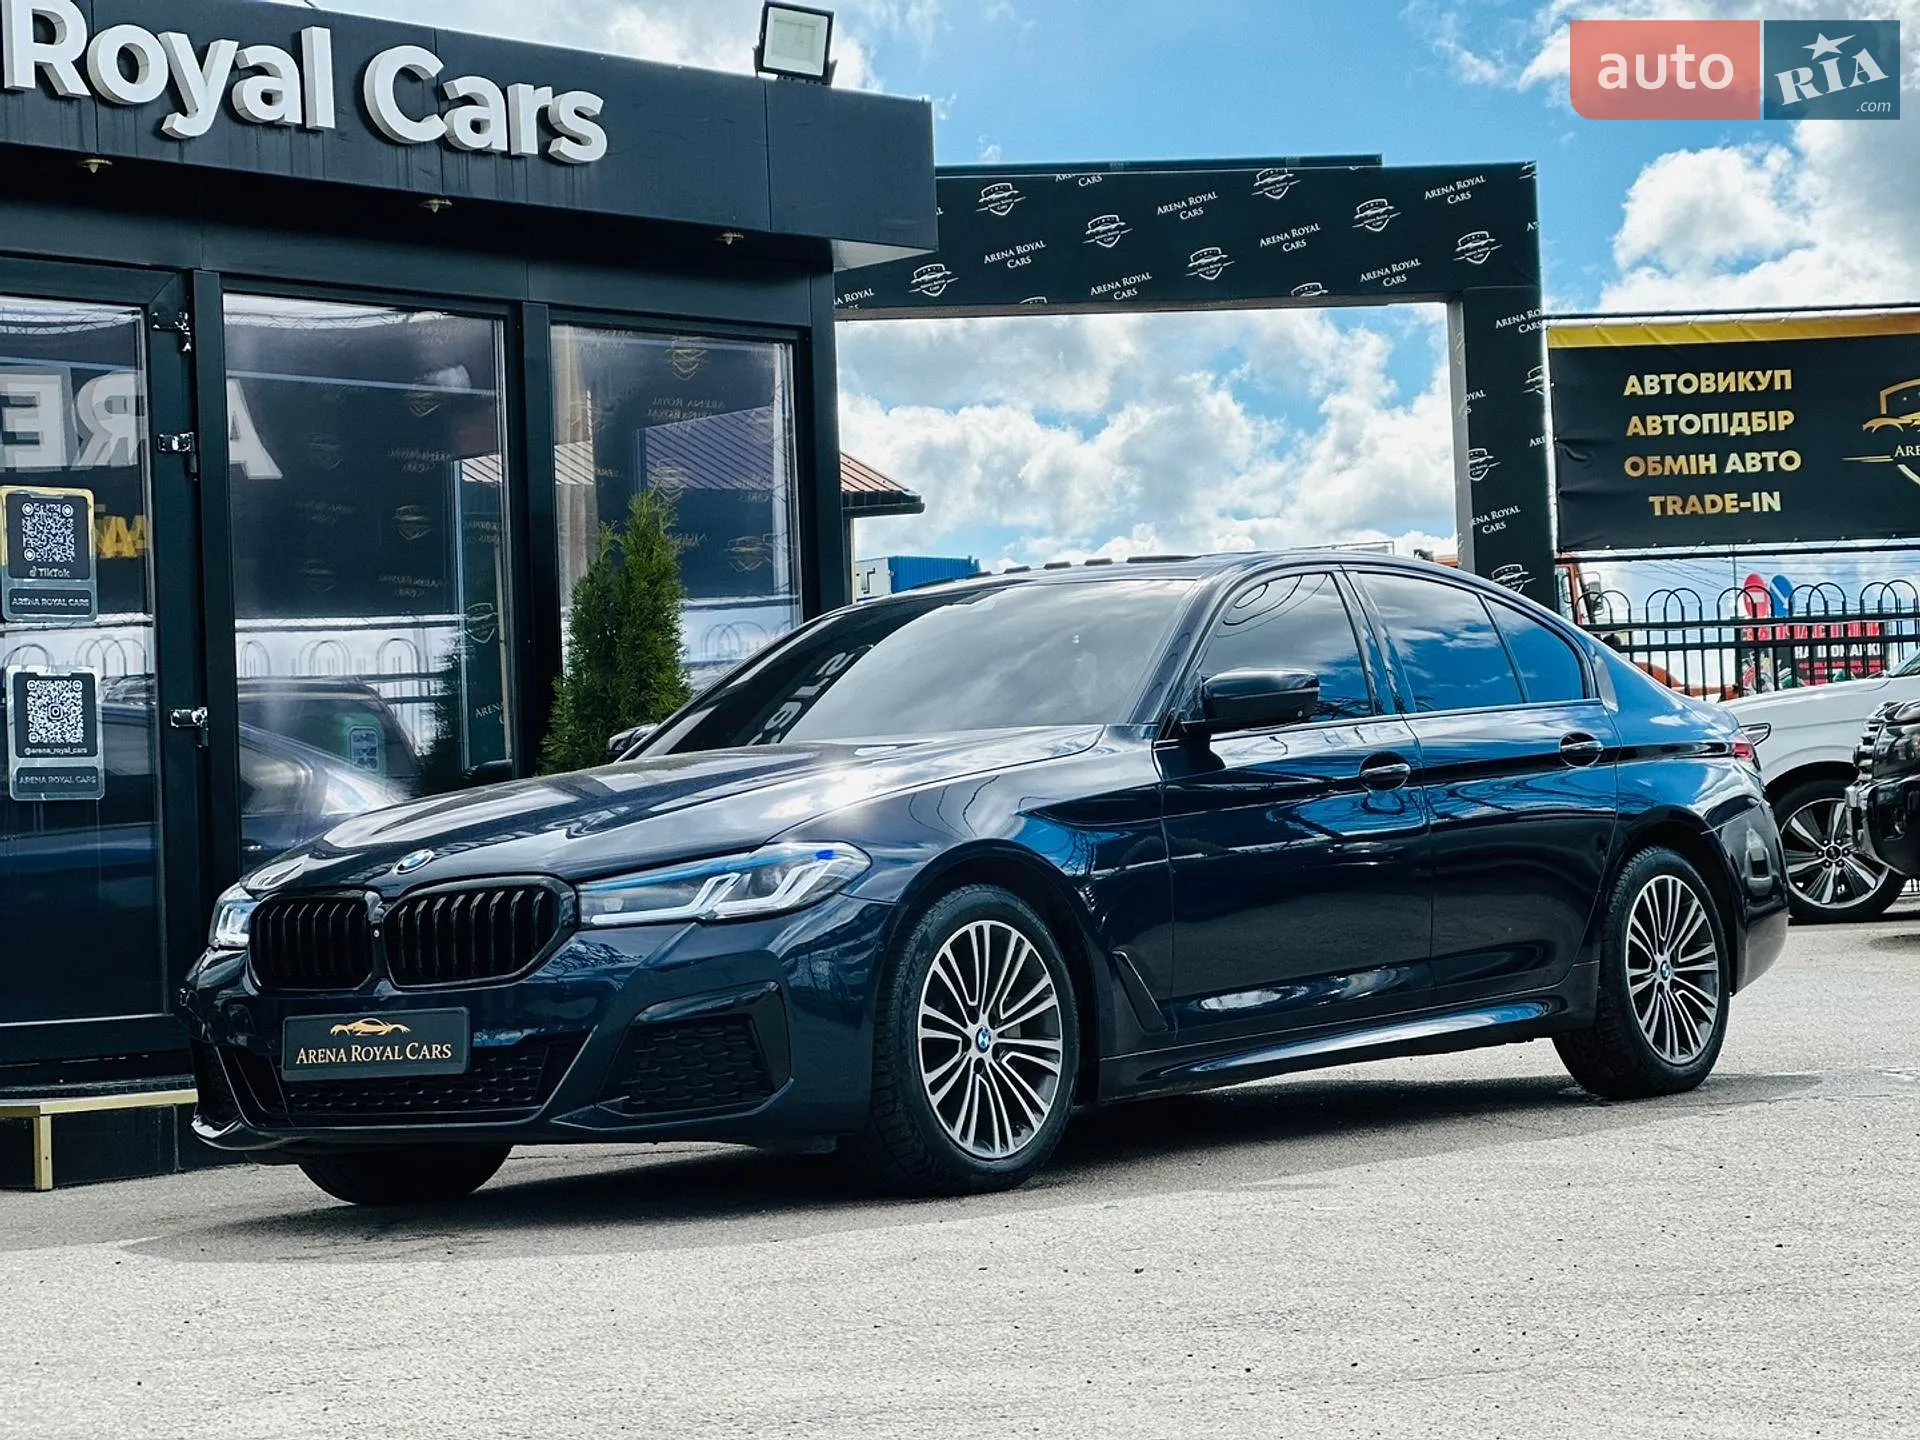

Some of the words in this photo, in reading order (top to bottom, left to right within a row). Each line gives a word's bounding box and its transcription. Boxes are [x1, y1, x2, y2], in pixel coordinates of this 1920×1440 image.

[3, 0, 335, 139] Royal
[363, 45, 608, 164] Cars
[1424, 184, 1455, 200] ARENA
[1456, 175, 1487, 190] ROYAL
[1157, 200, 1188, 215] ARENA
[1188, 191, 1218, 206] ROYAL
[1447, 190, 1472, 204] CARS
[1180, 206, 1204, 220] CARS
[1260, 232, 1290, 248] ARENA
[1291, 223, 1321, 238] ROYAL
[984, 248, 1015, 264] ARENA
[1016, 240, 1047, 255] ROYAL
[1282, 239, 1307, 252] CARS
[1007, 255, 1032, 269] CARS
[1360, 267, 1391, 283] ARENA
[1391, 258, 1422, 273] ROYAL
[1090, 281, 1121, 296] ARENA
[1122, 272, 1153, 287] ROYAL
[1382, 273, 1407, 287] CARS
[844, 288, 875, 303] ROYAL
[1113, 287, 1138, 300] CARS
[1495, 314, 1526, 329] ARENA
[1623, 369, 1792, 396] АВТОВИКУП
[1626, 410, 1796, 438] АВТОПІДБІР
[1624, 455, 1717, 478] ОБМІН
[1724, 450, 1802, 474] АВТО
[1490, 505, 1521, 520] ROYAL
[1649, 491, 1781, 516] TRADE-IN
[1482, 521, 1507, 534] CARS
[38, 567, 71, 578] TikTok
[12, 597, 40, 606] ARENA
[41, 598, 68, 607] ROYAL
[68, 599, 89, 607] CARS
[296, 1047, 347, 1064] ARENA
[351, 1044, 403, 1062] ROYAL
[406, 1042, 452, 1060] CARS
